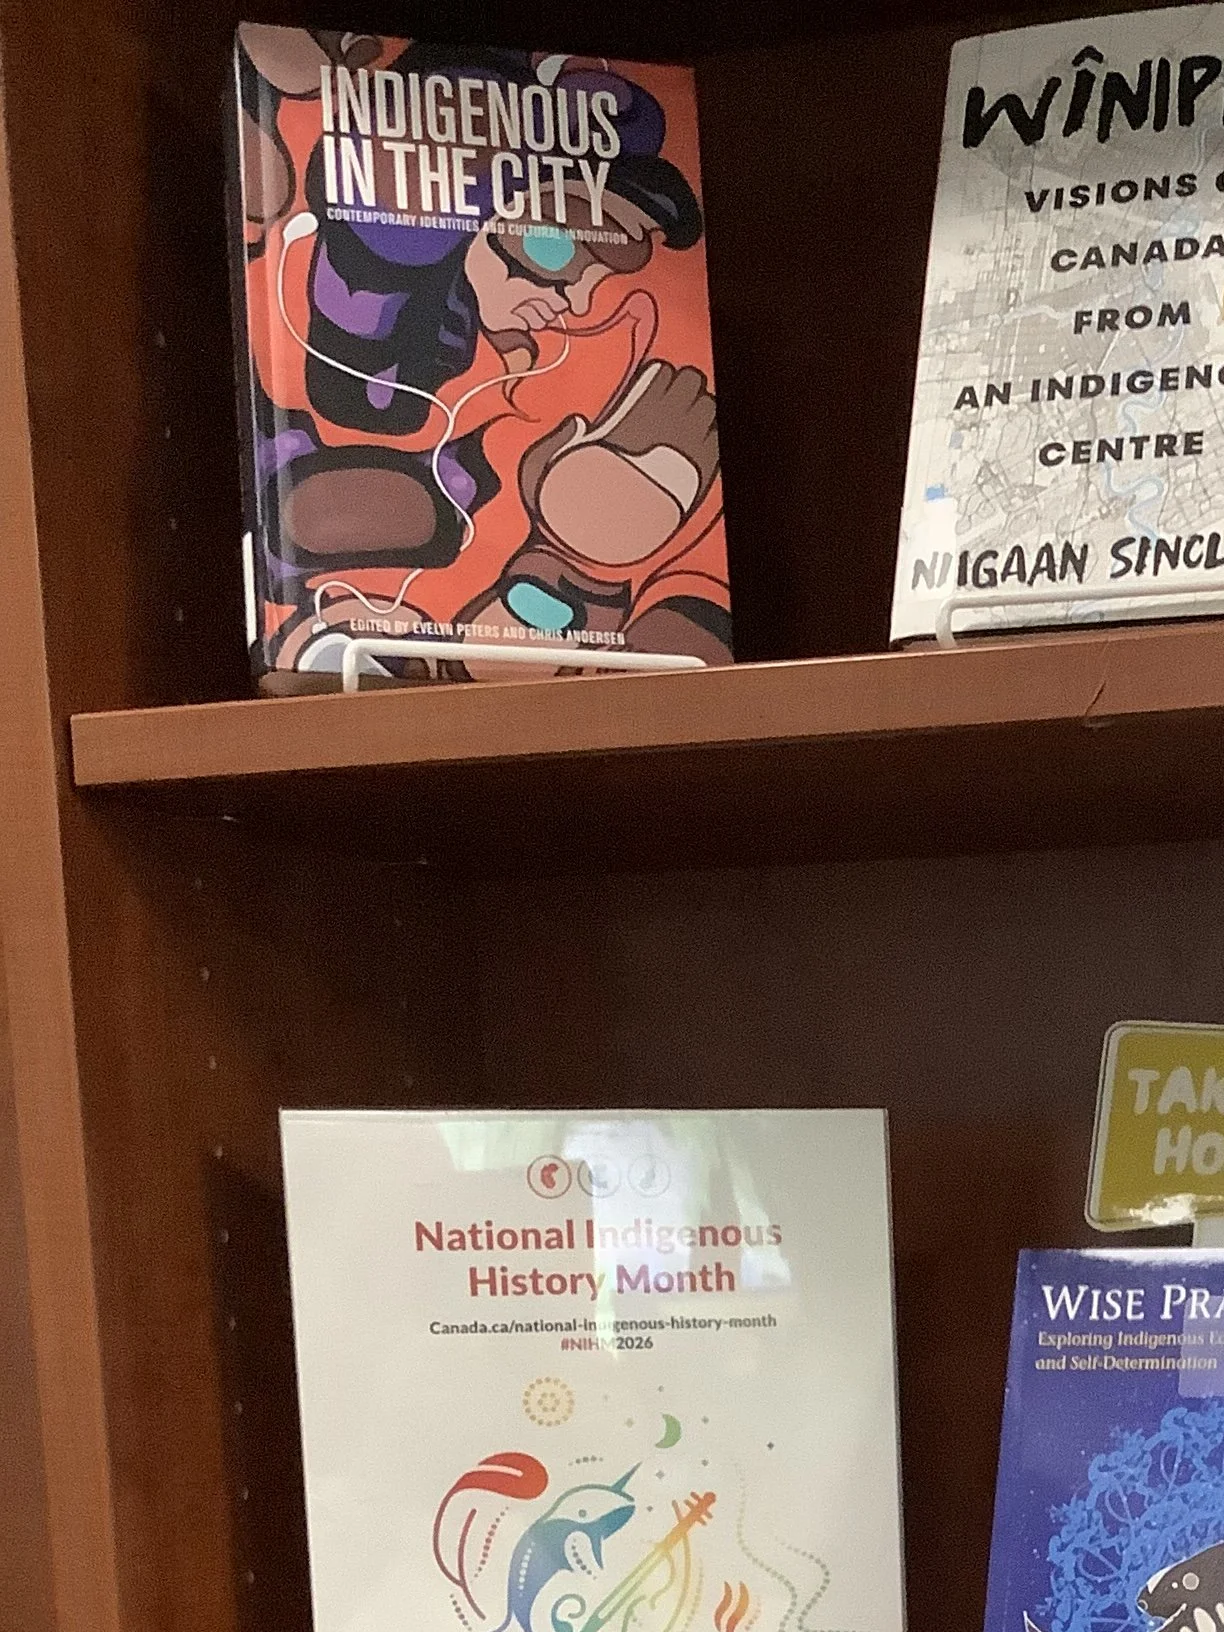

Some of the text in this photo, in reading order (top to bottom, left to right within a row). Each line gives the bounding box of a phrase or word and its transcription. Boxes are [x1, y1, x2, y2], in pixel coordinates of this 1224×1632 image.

[321, 65, 620, 159] INDIGENOUS
[323, 135, 610, 226] IN THE CITY
[1024, 172, 1197, 213] VISIONS
[327, 207, 628, 245] CONTEMPORARY IDENTITIES AND CULTURAL INNOVATION
[1073, 301, 1191, 335] FROM
[953, 383, 1011, 410] AN
[1039, 430, 1205, 467] CENTRE
[912, 542, 1088, 590] NIIGAAN
[350, 619, 625, 645] EDITED BY EVELYN PETERS AND CHRIS ANDERSEN
[415, 1219, 782, 1253] National Indigenous
[469, 1262, 735, 1301] History Month
[1042, 1285, 1145, 1321] WISE
[1038, 1331, 1113, 1348] Exploring
[1117, 1332, 1204, 1349] Indigenous
[1035, 1355, 1218, 1371] and Self-Determination
